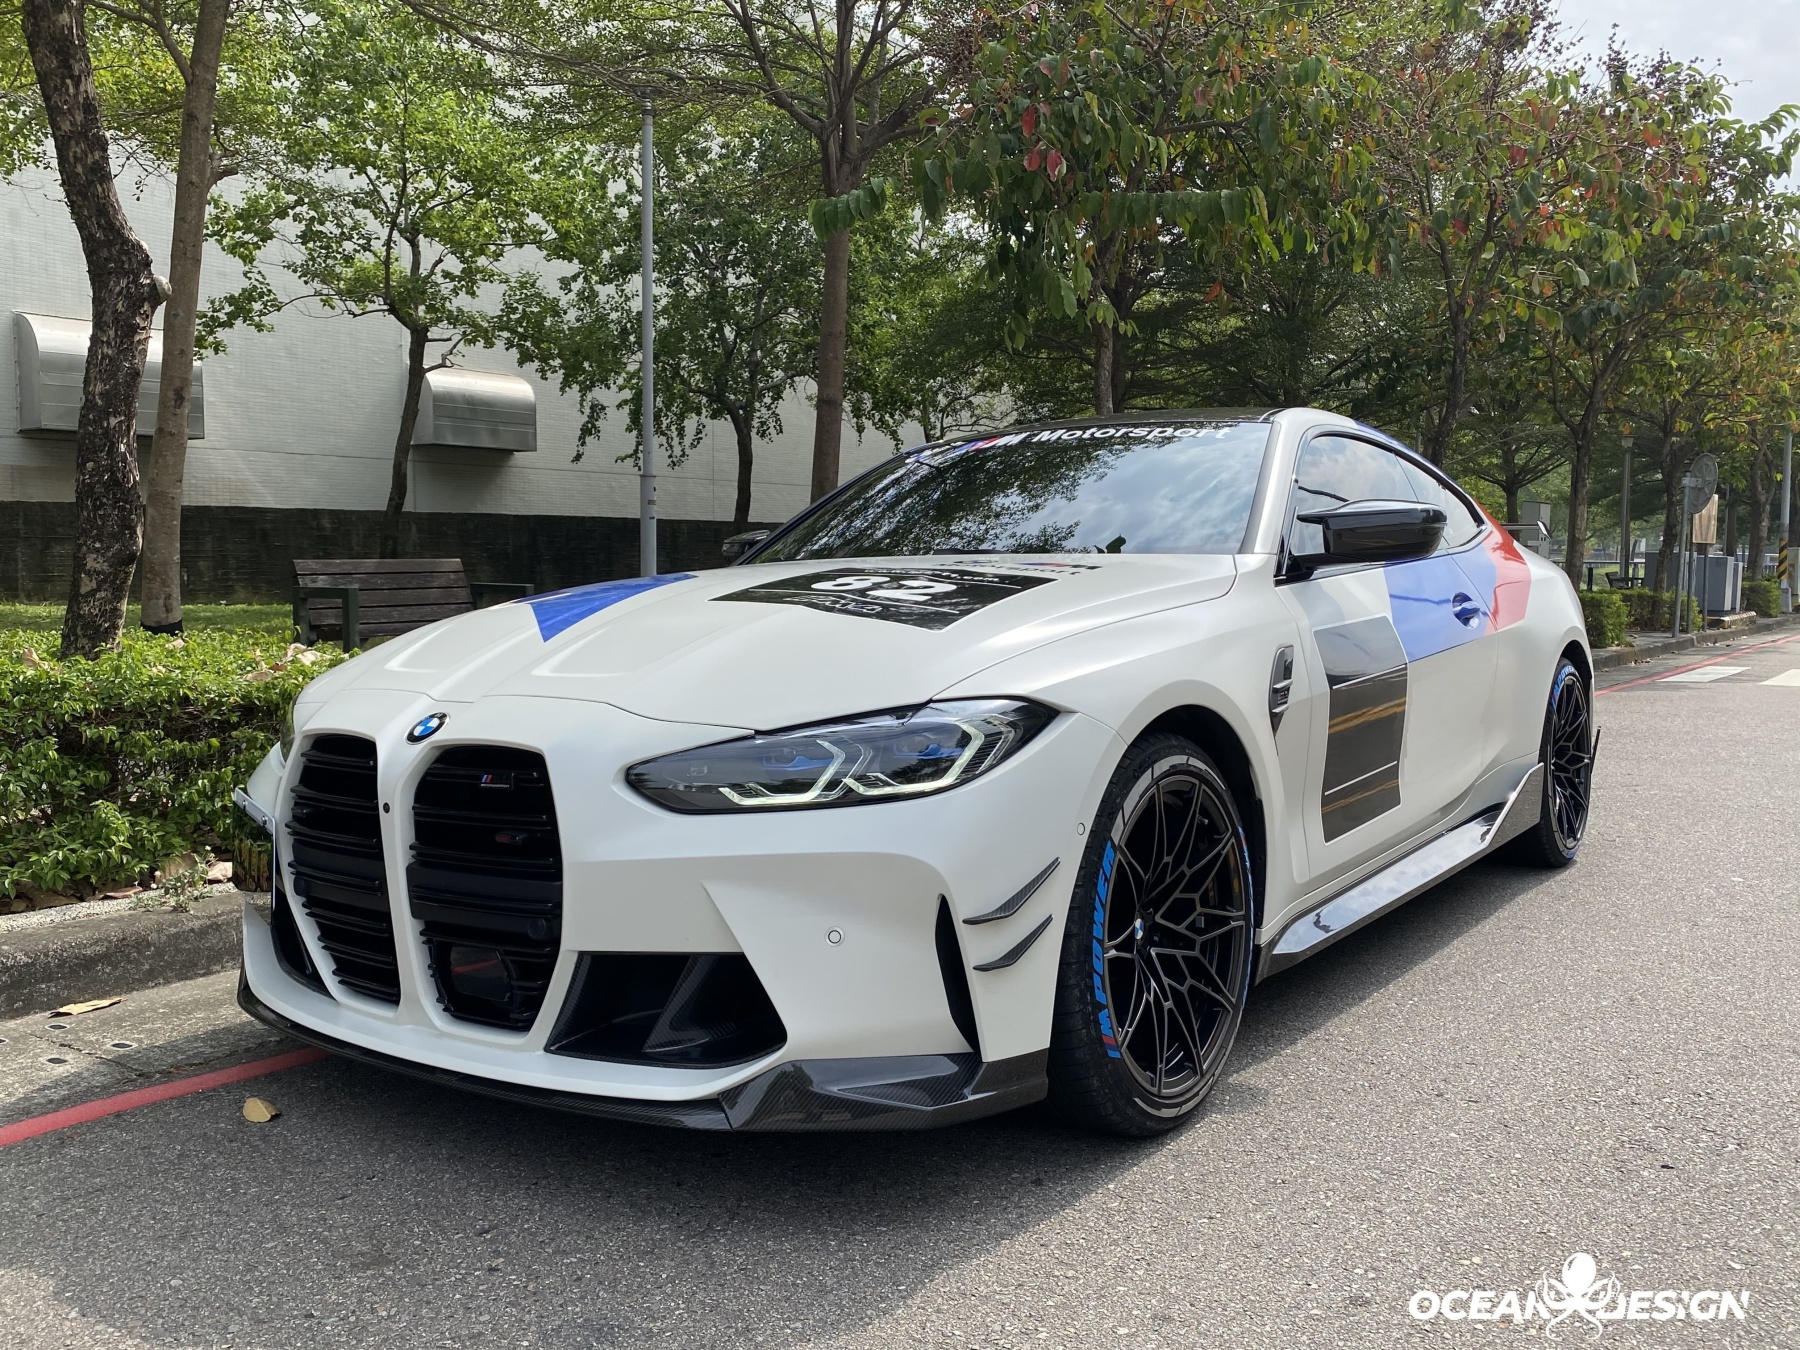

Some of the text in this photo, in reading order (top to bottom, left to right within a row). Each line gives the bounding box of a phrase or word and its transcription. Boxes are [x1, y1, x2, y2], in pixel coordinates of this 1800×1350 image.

[1031, 426, 1231, 443] Motorsport
[811, 576, 957, 601] 82
[1092, 840, 1115, 1004] POWER
